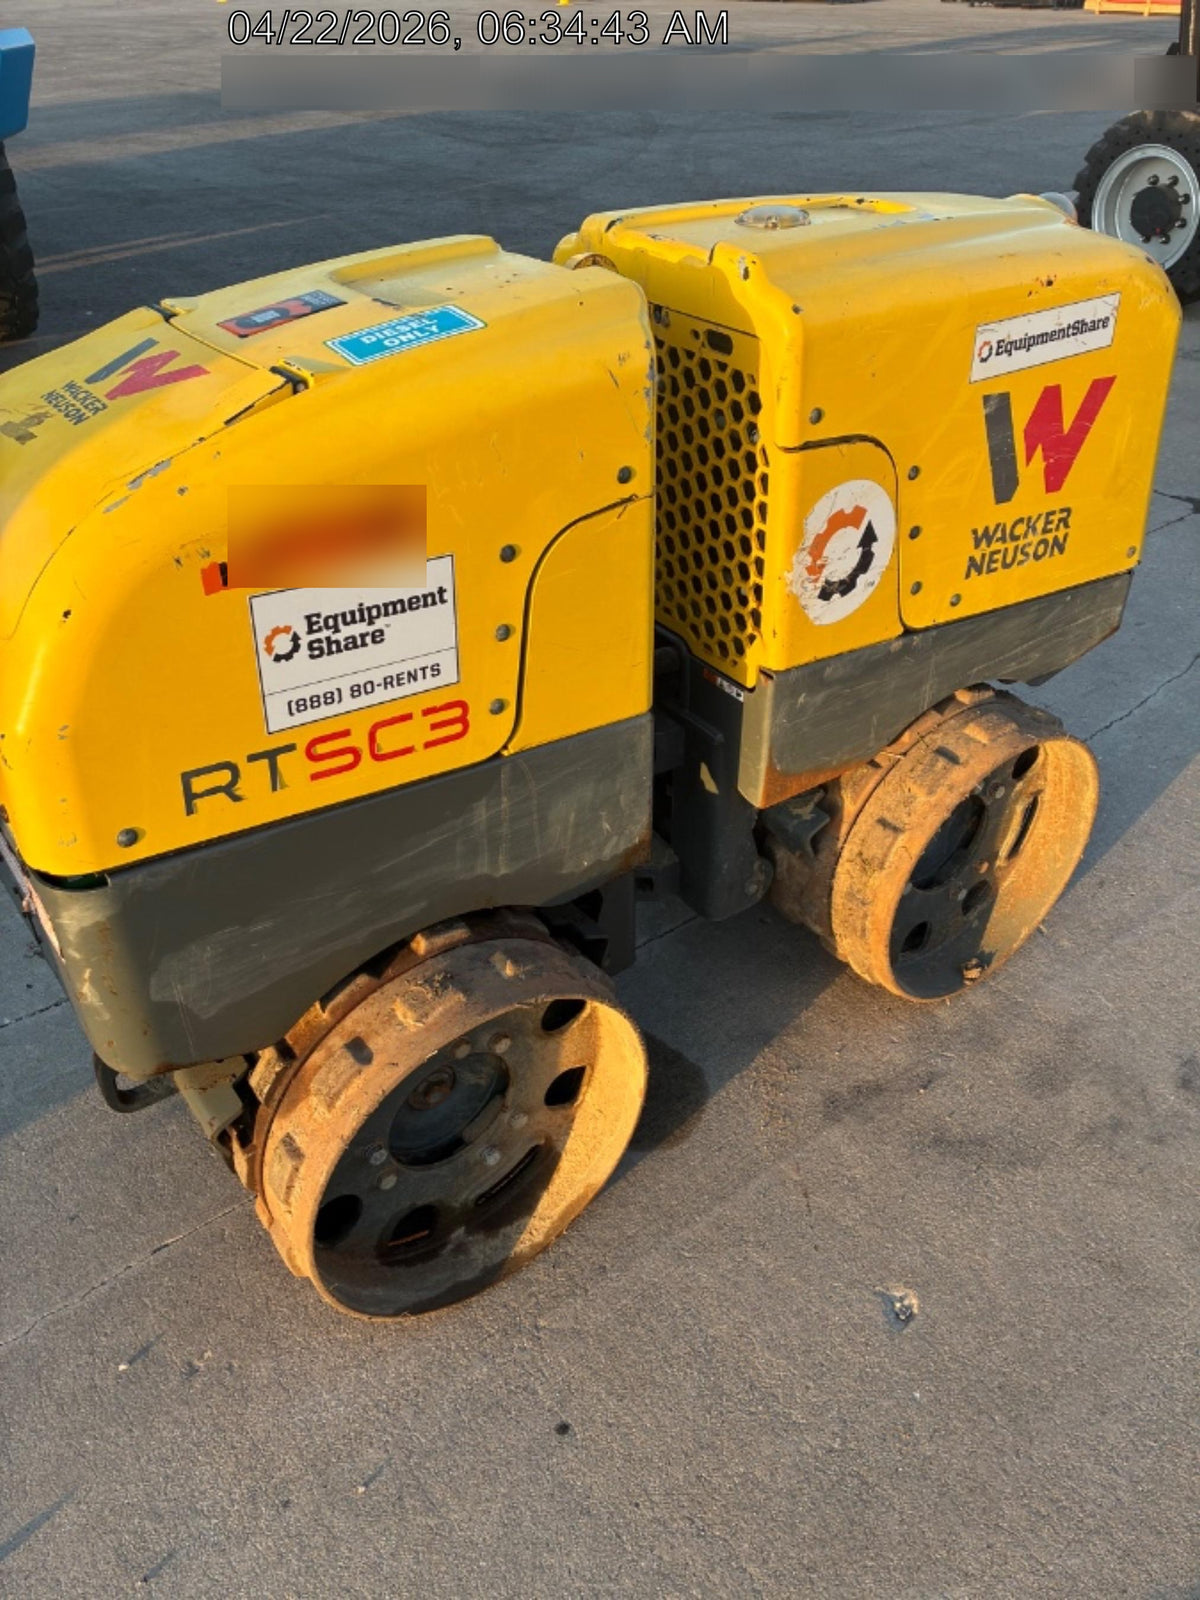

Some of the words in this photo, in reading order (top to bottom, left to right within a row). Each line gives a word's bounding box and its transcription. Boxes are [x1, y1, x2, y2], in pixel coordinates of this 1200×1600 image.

[360, 318, 438, 344] DIESEL
[383, 325, 440, 347] ONLY
[995, 315, 1110, 357] EquipmentShare
[40, 389, 91, 426] NEUSON
[62, 380, 108, 417] WACKER
[971, 507, 1072, 550] WACKER
[964, 532, 1069, 580] NEUSON
[304, 586, 448, 635] Equipment
[306, 628, 386, 660] Share
[287, 687, 343, 716] (888)
[349, 662, 442, 699] 80-RENTS
[180, 699, 470, 816] RTSC3
